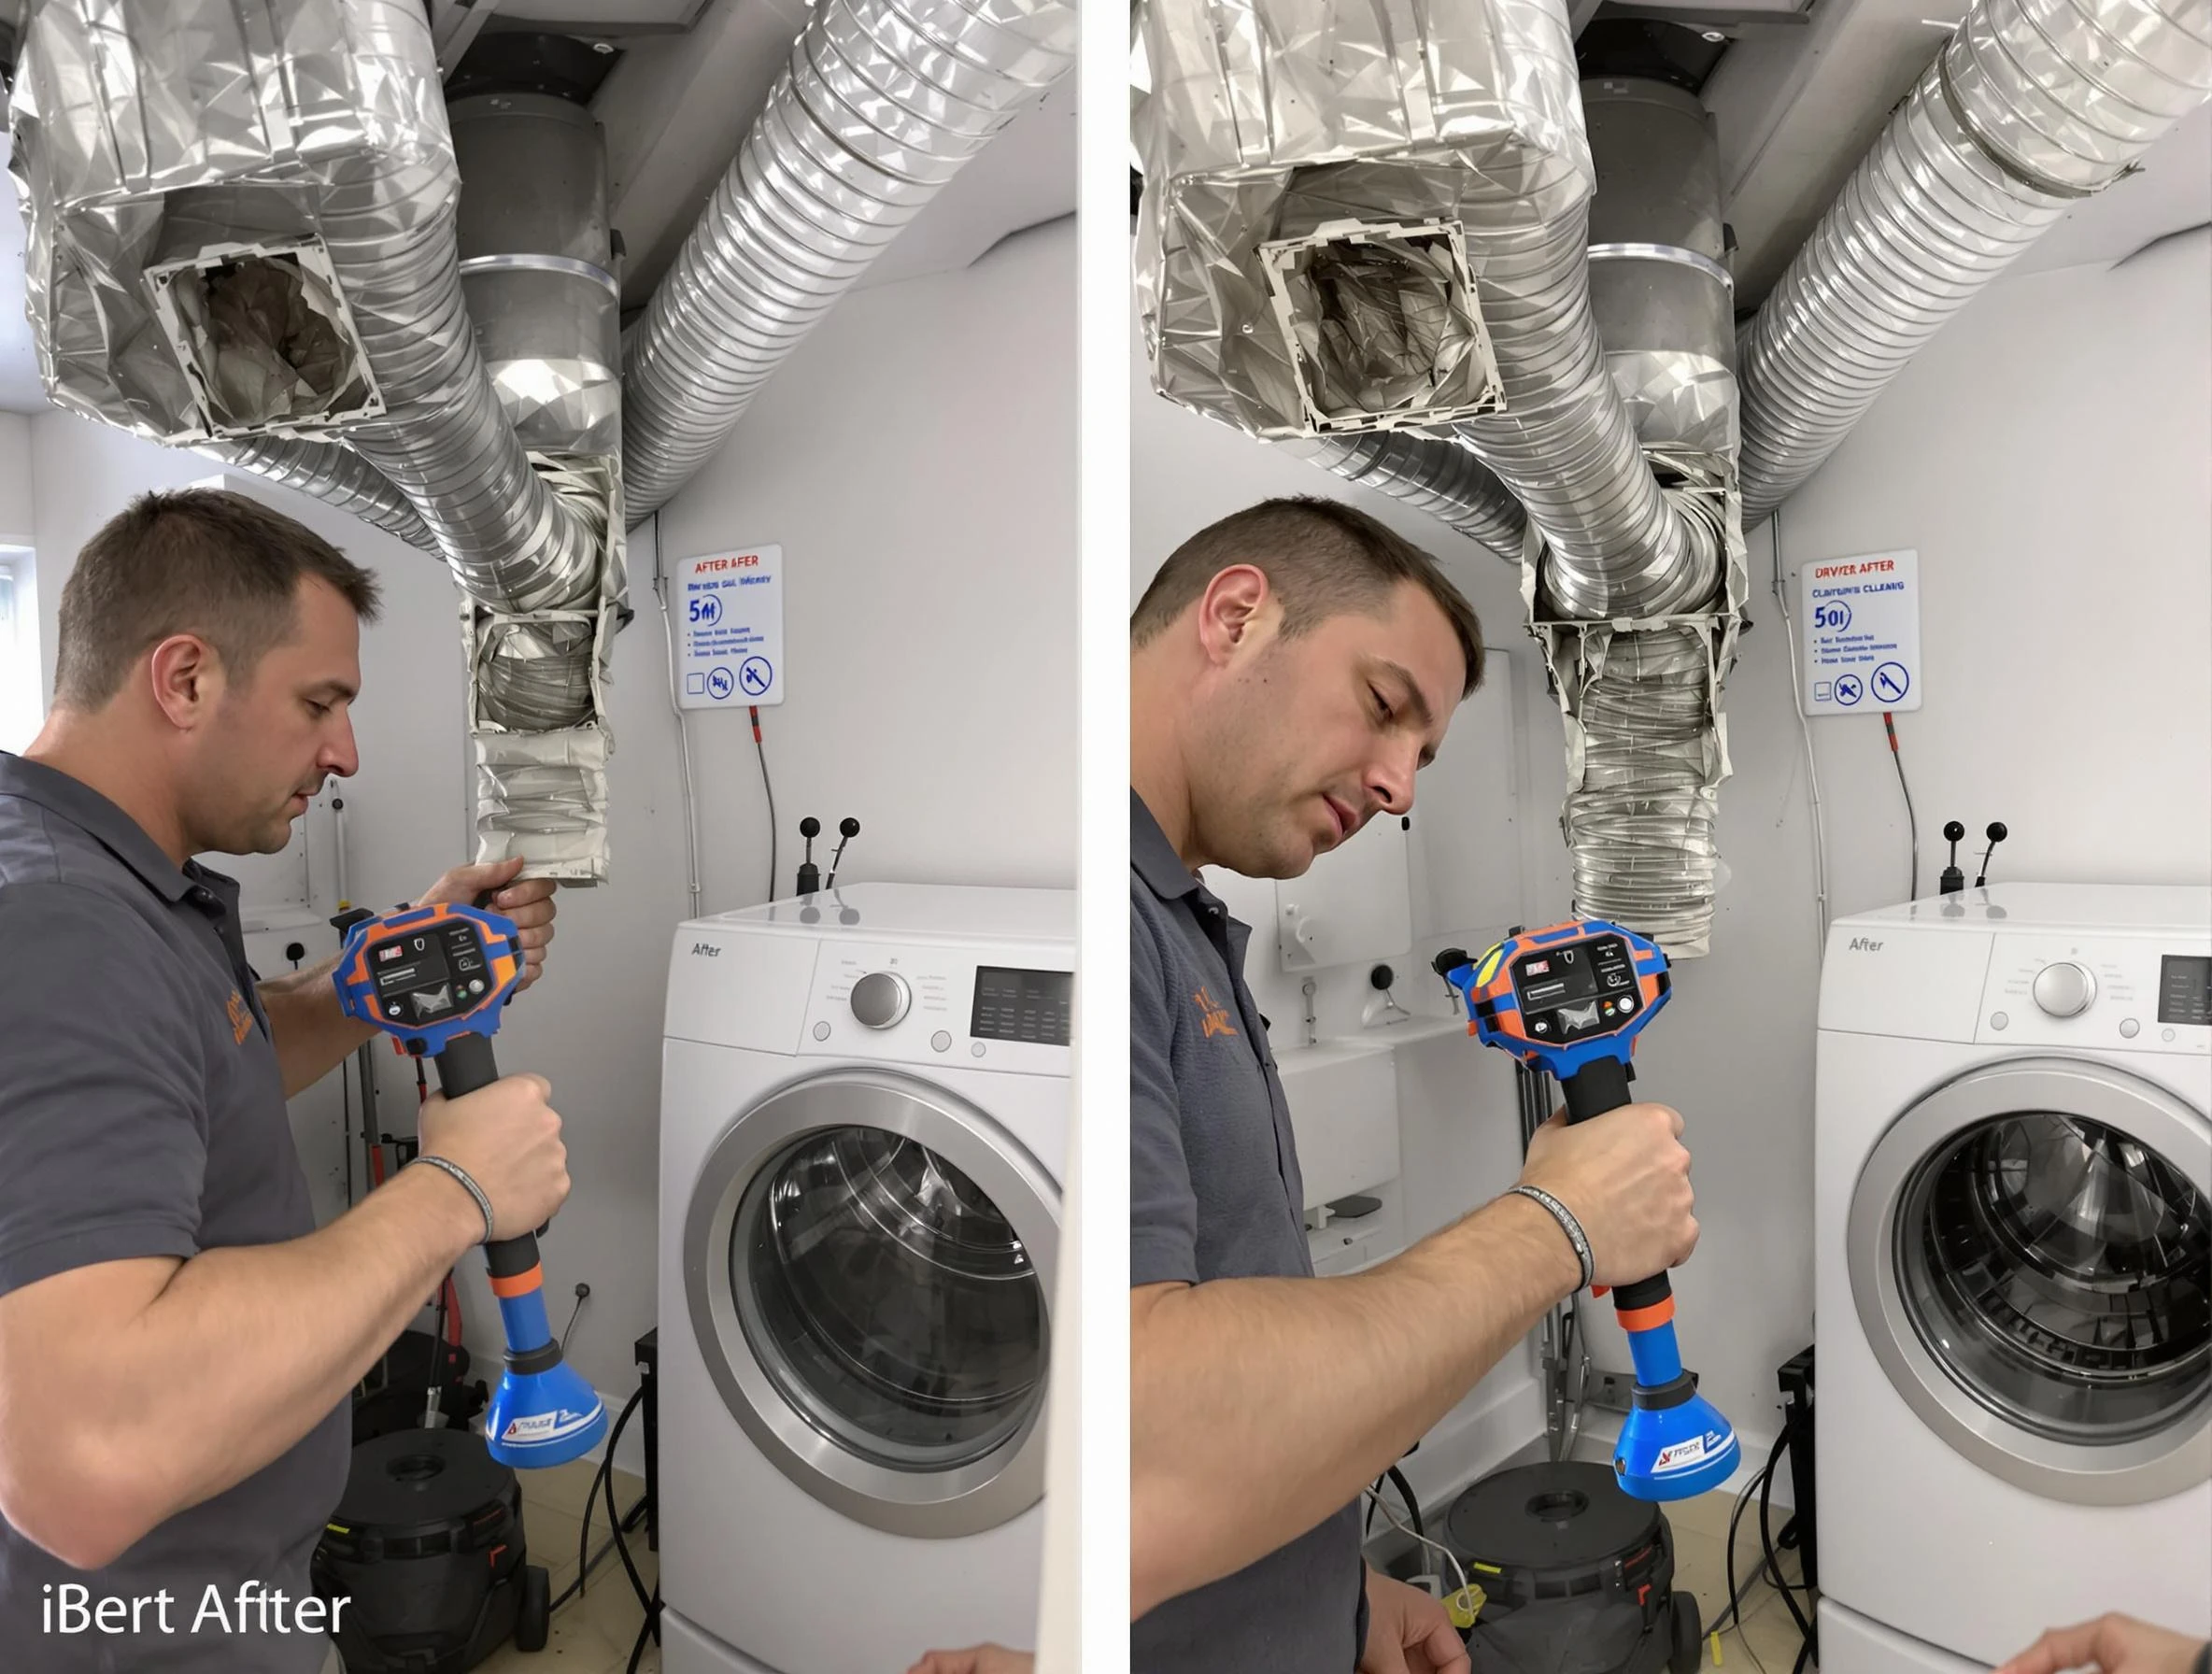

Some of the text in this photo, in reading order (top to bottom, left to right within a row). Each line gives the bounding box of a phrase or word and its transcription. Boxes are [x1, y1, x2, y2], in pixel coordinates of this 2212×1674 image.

[695, 560, 729, 574] AFTER
[1859, 560, 1894, 574] AFTER
[1849, 937, 1884, 952] After
